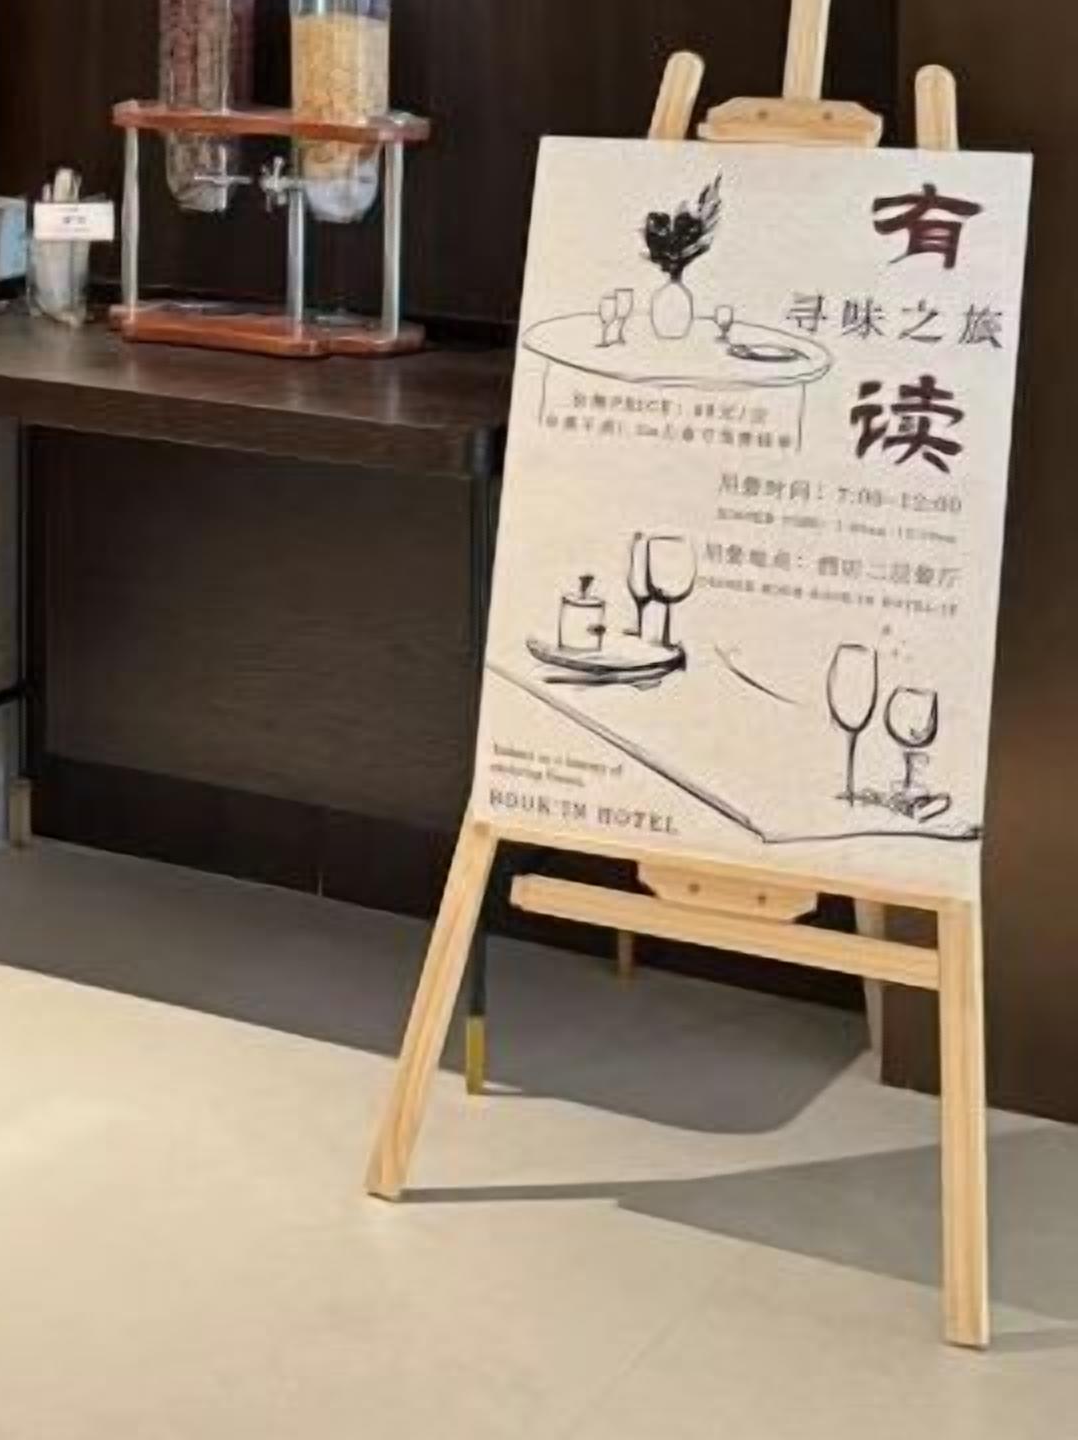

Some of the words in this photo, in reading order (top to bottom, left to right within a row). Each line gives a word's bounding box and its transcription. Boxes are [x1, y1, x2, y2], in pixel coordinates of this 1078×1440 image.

[871, 183, 984, 270] 有
[785, 292, 1003, 349] 寻味之旅
[849, 374, 965, 474] 读
[597, 806, 681, 834] HOTEL
